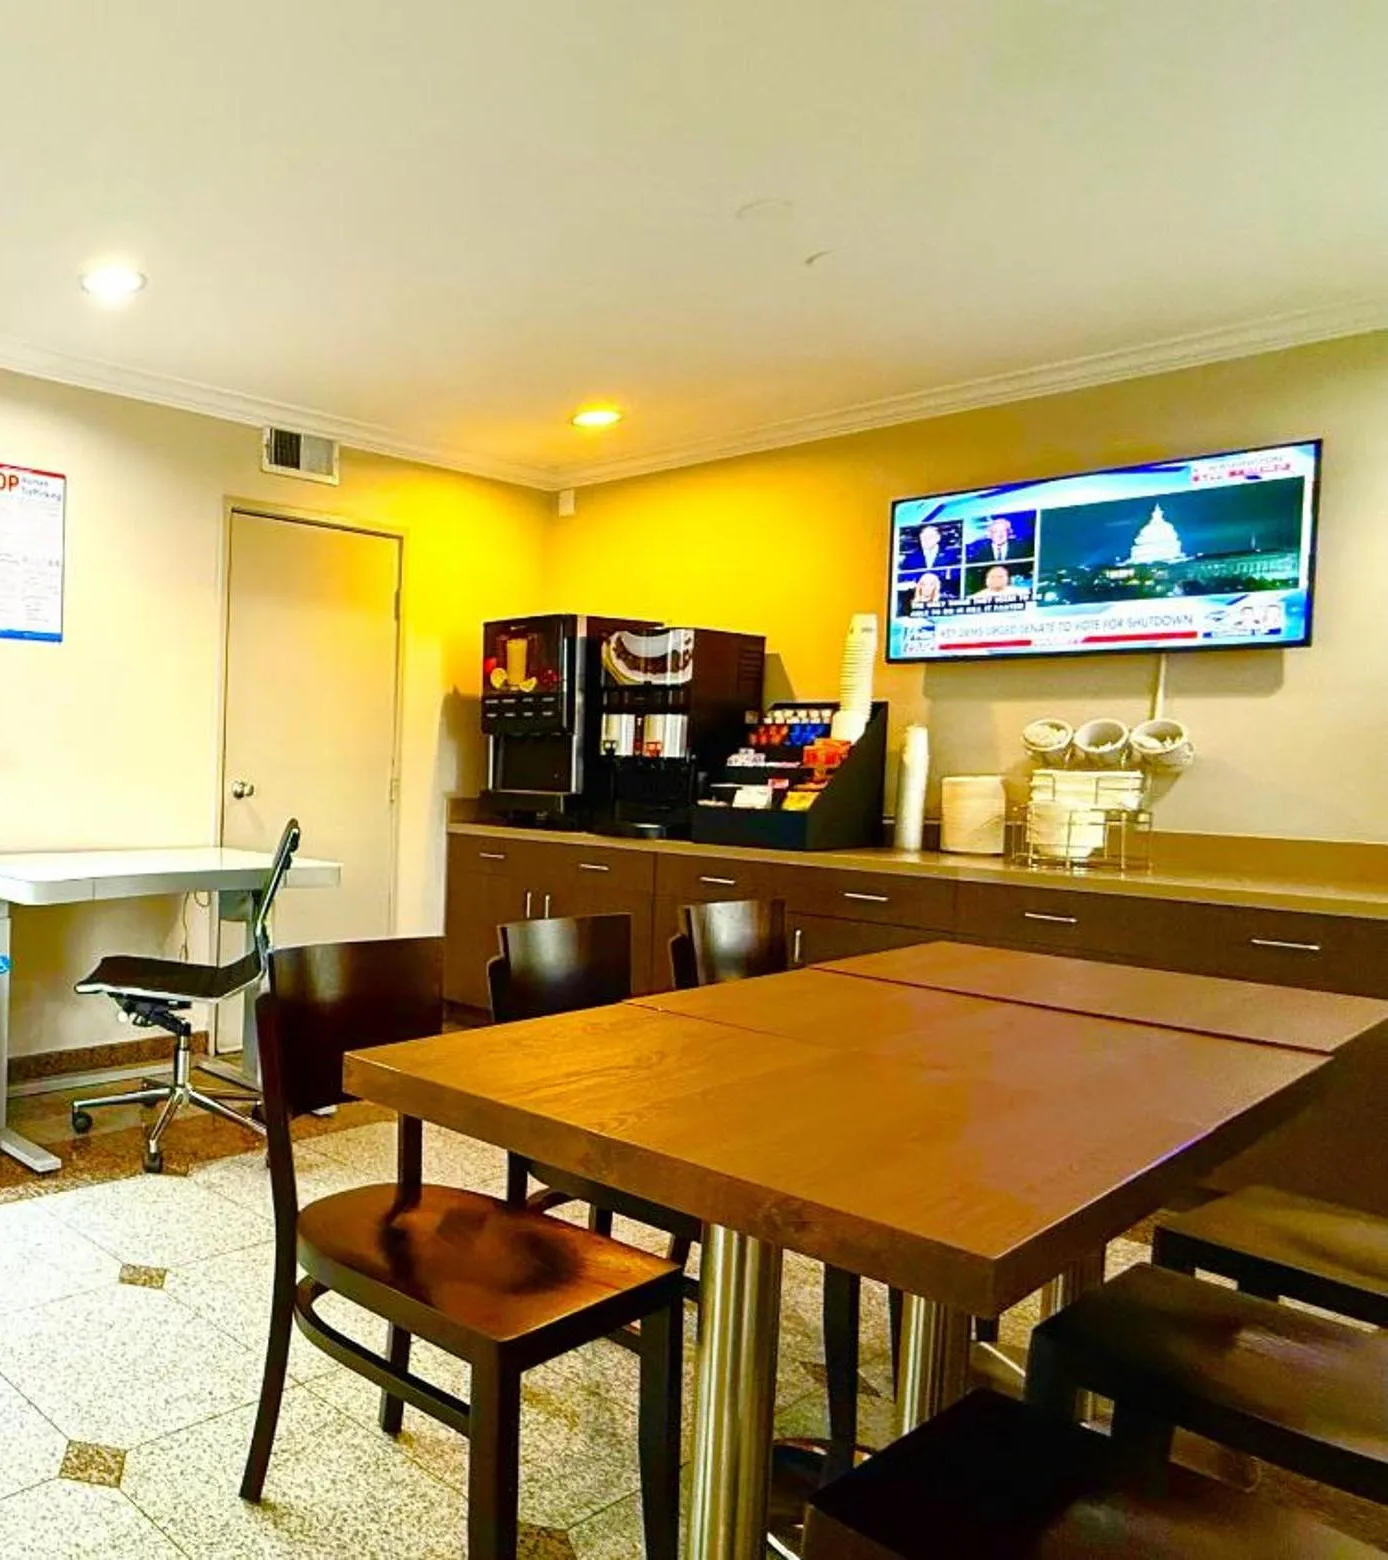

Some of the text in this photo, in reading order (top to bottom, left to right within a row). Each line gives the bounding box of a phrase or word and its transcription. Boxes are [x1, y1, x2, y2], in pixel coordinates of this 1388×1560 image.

[1058, 621, 1071, 632] TO
[1075, 619, 1100, 631] VOTE
[1103, 618, 1123, 630] FOR
[1126, 614, 1193, 629] SHUTDOWN
